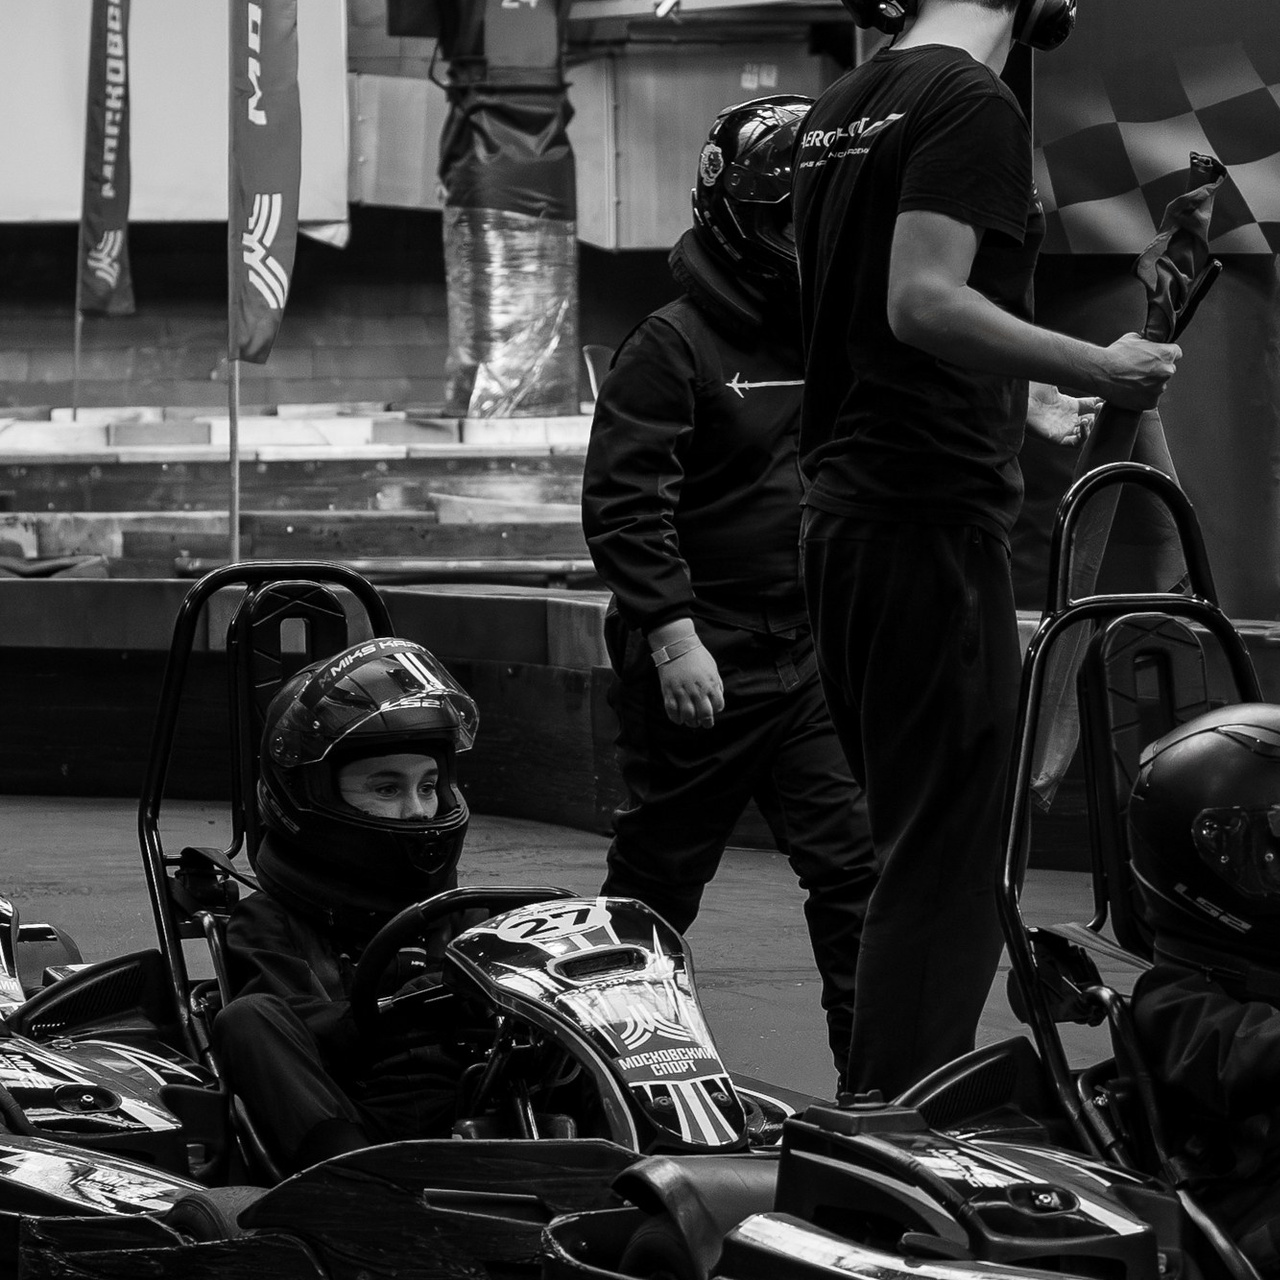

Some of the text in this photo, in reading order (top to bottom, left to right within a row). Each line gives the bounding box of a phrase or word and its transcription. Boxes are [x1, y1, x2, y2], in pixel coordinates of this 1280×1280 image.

[330, 645, 376, 677] MIKS
[507, 907, 591, 940] 27
[618, 1046, 717, 1070] МОСКОВСКИЙ
[651, 1059, 697, 1076] СПОРТ
